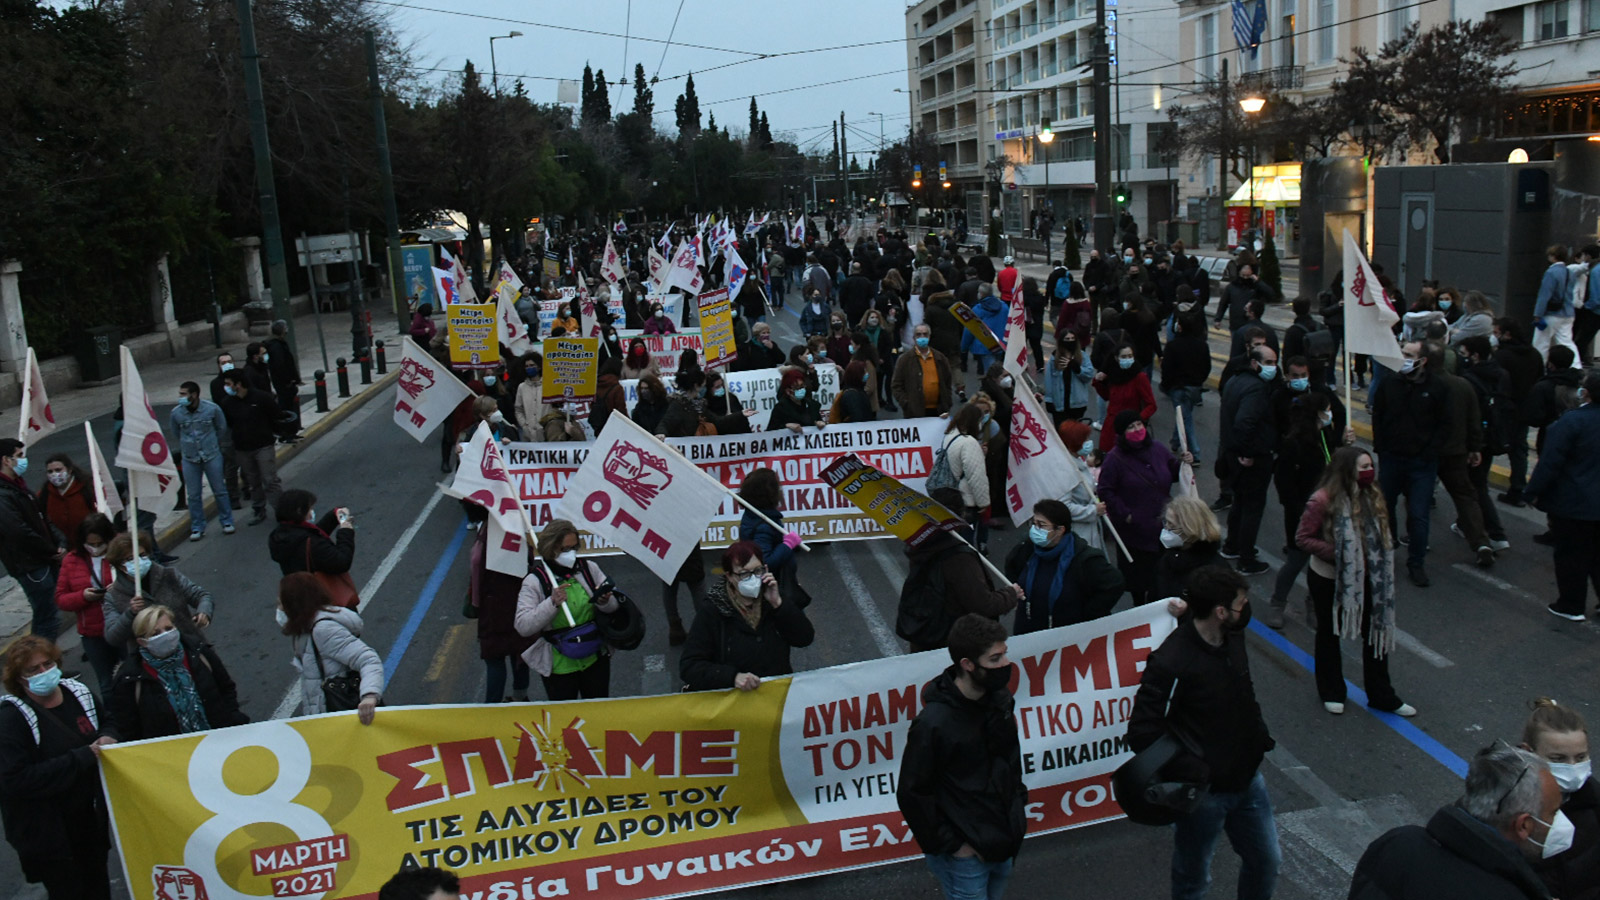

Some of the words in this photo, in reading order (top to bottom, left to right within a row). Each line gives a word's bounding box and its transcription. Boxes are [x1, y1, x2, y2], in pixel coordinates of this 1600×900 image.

[510, 449, 567, 465] ΚΡΑΤΙΚΗ
[691, 444, 714, 460] ΒΙΑ
[719, 442, 746, 458] ΔΕΝ
[750, 440, 767, 454] ΘΑ
[773, 436, 800, 451] ΜΑΣ
[805, 432, 853, 449] ΚΛΕΙΣΕΙ
[858, 430, 873, 446] ΤΟ
[877, 427, 921, 445] ΣΤΟΜΑ
[863, 451, 926, 476] ΓΩΝΑ
[829, 517, 887, 535] ΓΑΛΑΤΣ
[803, 731, 893, 777] ΤΟΝ
[1092, 696, 1137, 730] ΑΓΩ
[376, 725, 740, 814] ΣΠΑΜΕ
[815, 779, 848, 804] ΓΙΑ
[852, 773, 896, 799] ΥΓΕΙ
[1042, 736, 1130, 770] ΔΙΚΑΙΩΜ
[184, 719, 346, 899] 8
[399, 825, 583, 872] ΑΤΟΜΙΚΟΥ
[593, 805, 743, 845] ΔΡΟΜΟΥ
[405, 813, 465, 844] ΤΙΣ
[474, 792, 652, 834] ΑΛΥΣΙΔΕΣ
[659, 785, 728, 808] ΤΟΥ
[254, 838, 346, 873] ΜΑΡΤΗ
[274, 871, 334, 895] 2021
[585, 832, 823, 890] Γυναικών
[839, 818, 915, 853] Ελλ
